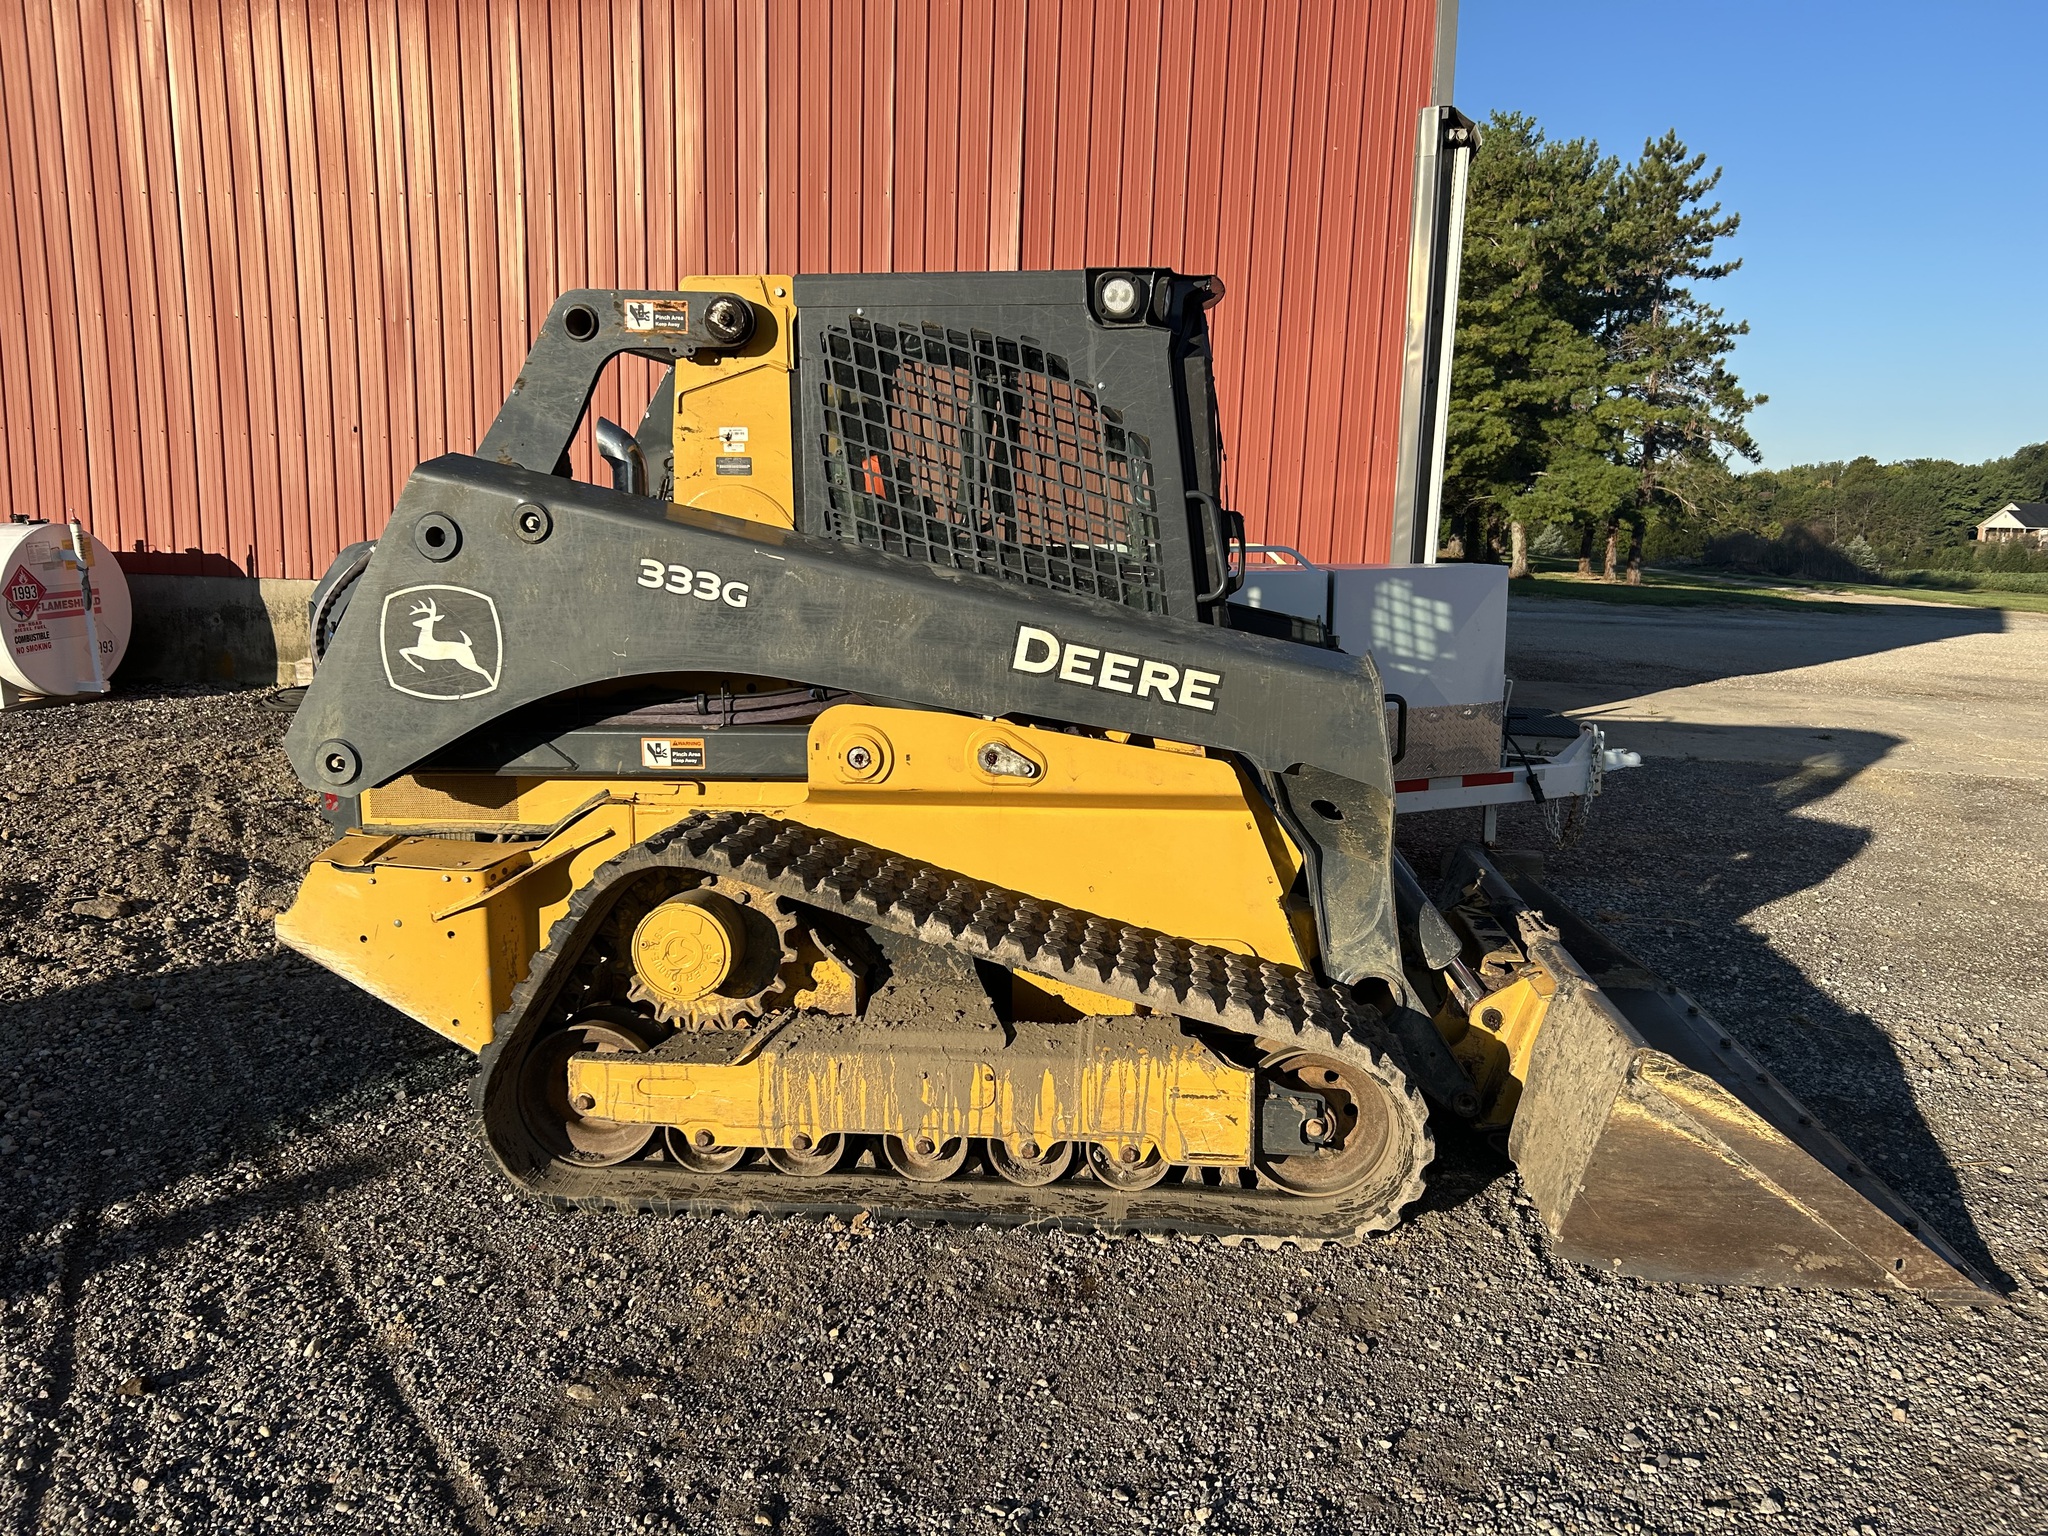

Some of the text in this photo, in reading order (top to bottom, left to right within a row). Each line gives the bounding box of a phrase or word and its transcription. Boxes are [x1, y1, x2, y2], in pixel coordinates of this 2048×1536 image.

[637, 558, 750, 609] 333G
[12, 585, 38, 601] 1993
[24, 604, 31, 612] 3
[36, 597, 100, 612] FLAMESHID
[14, 631, 51, 645] COMBUSTIBLE
[16, 642, 52, 655] NO SMOKING
[1012, 625, 1221, 711] DEERE
